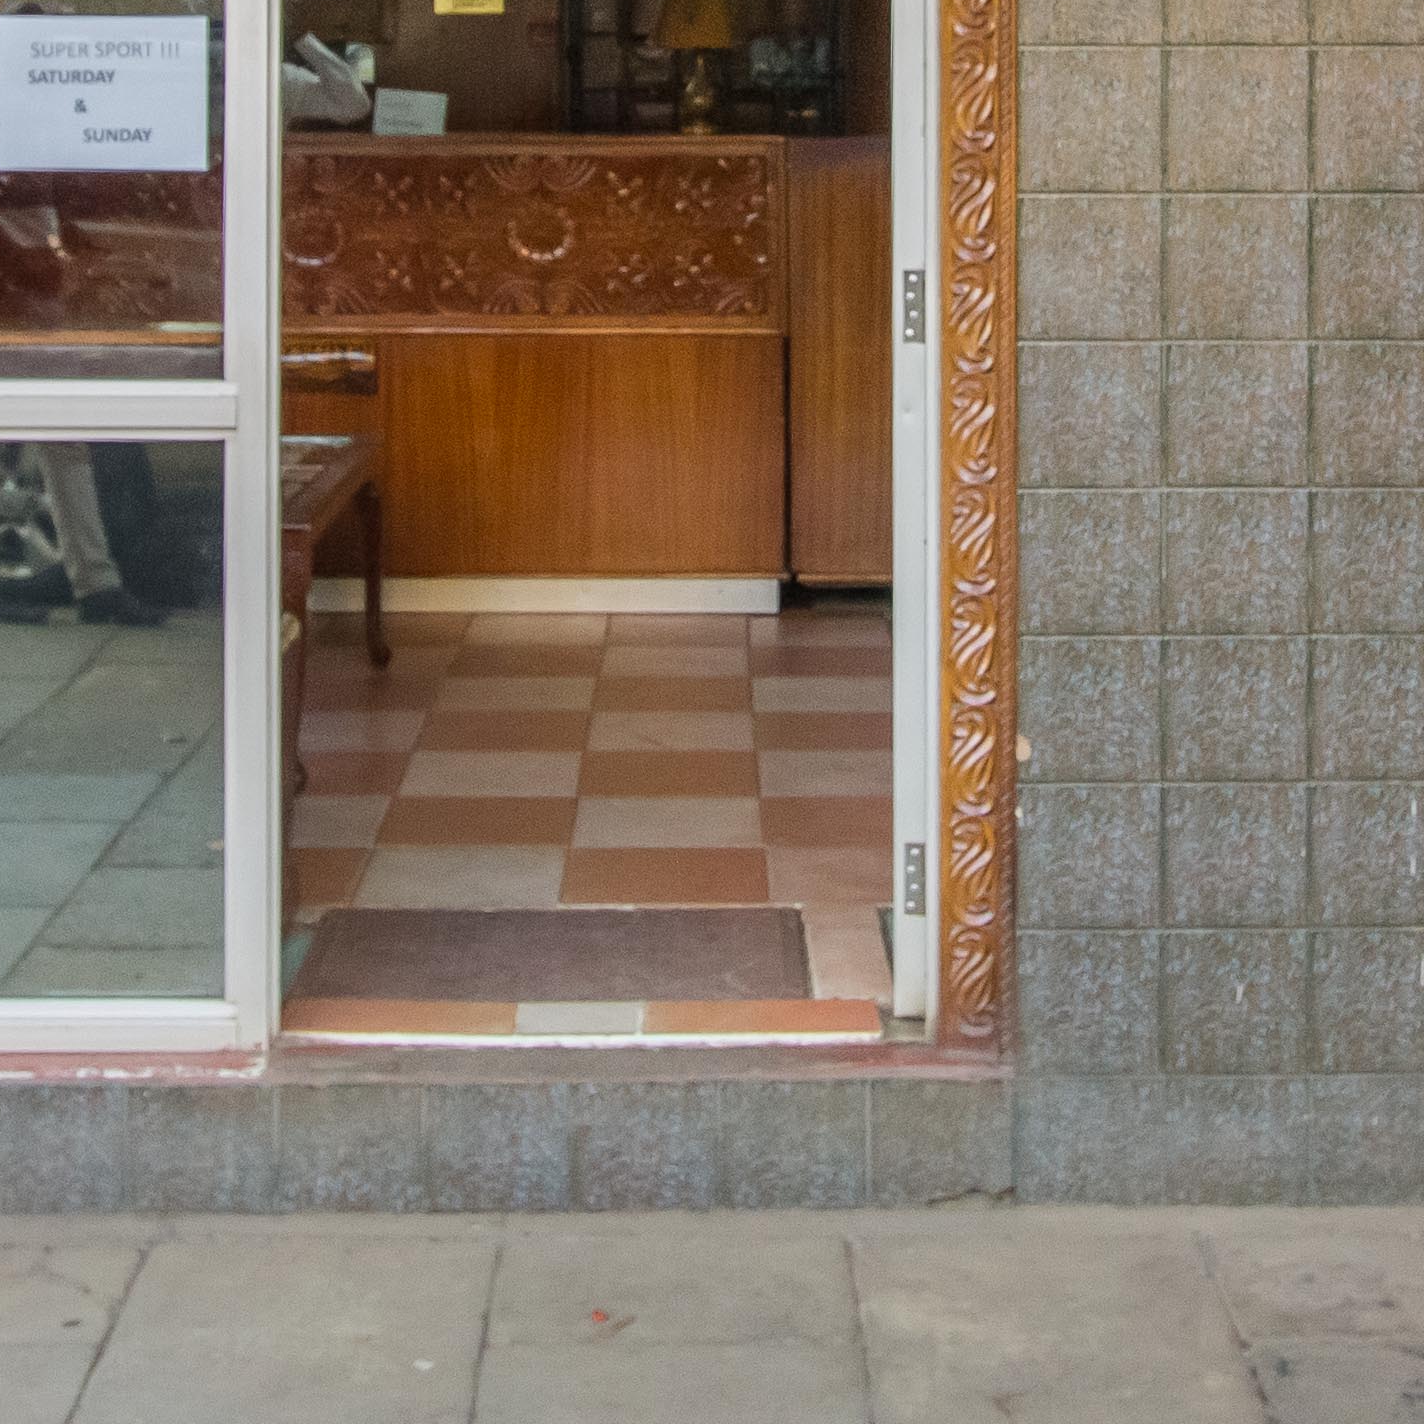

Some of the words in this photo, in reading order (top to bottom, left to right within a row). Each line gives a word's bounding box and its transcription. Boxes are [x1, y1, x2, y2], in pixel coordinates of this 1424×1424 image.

[30, 41, 89, 58] SUPER
[94, 41, 152, 58] SPORT
[27, 68, 116, 84] SATURDAY
[73, 98, 88, 114] &
[82, 127, 153, 143] SUNDAY
